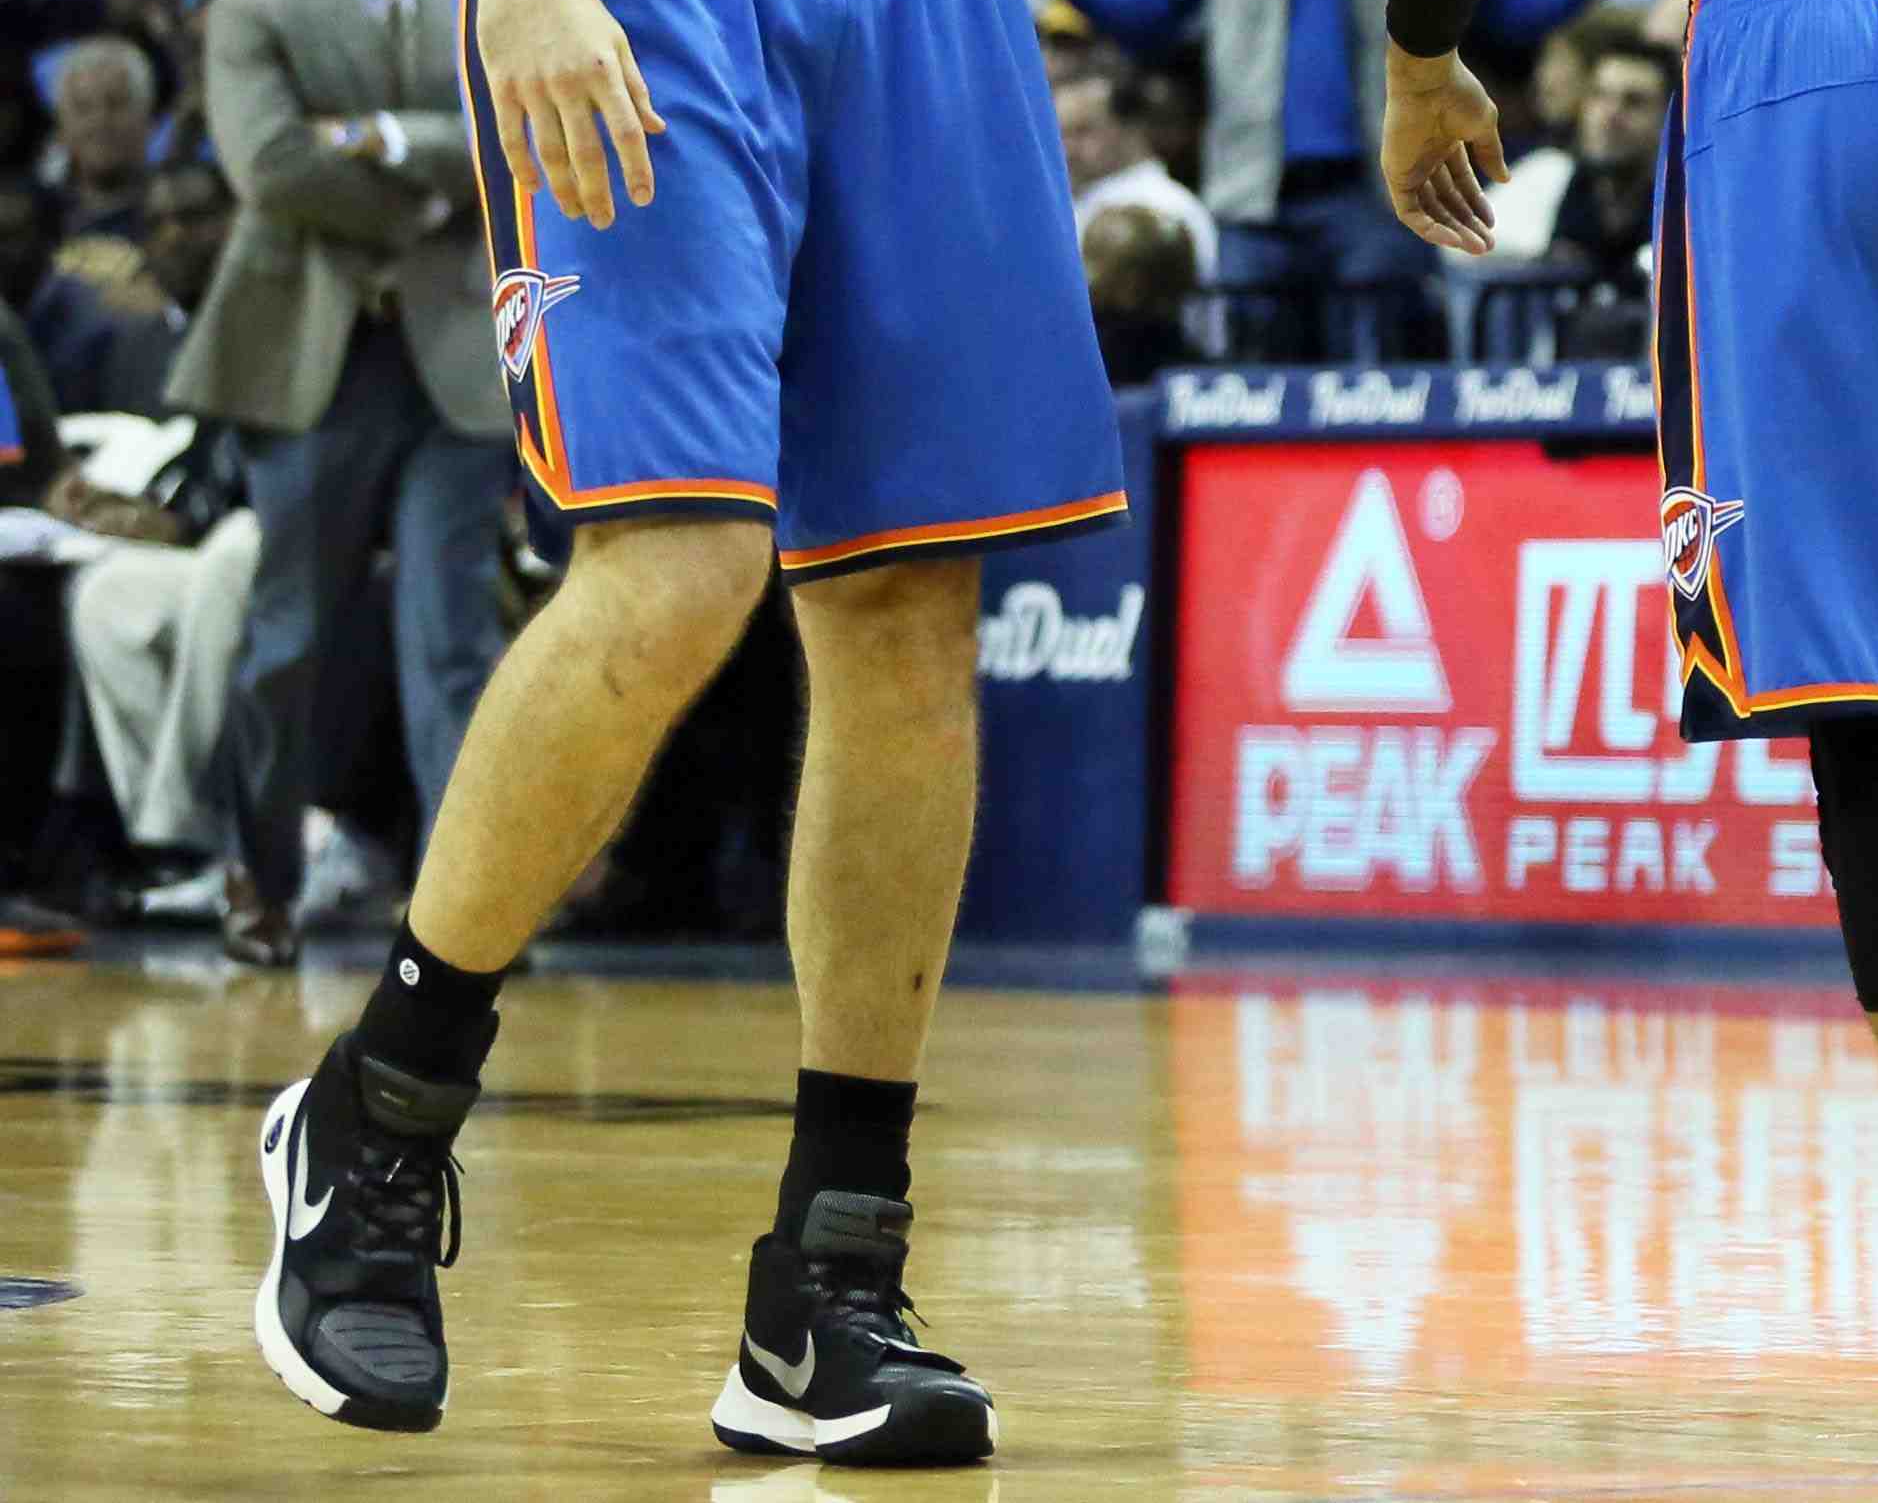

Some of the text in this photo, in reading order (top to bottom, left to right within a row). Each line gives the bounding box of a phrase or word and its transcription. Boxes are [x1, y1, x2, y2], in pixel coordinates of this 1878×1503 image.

[975, 581, 1144, 682] nDuel
[1232, 725, 1498, 892] PEAK
[1507, 816, 1717, 893] PEAK
